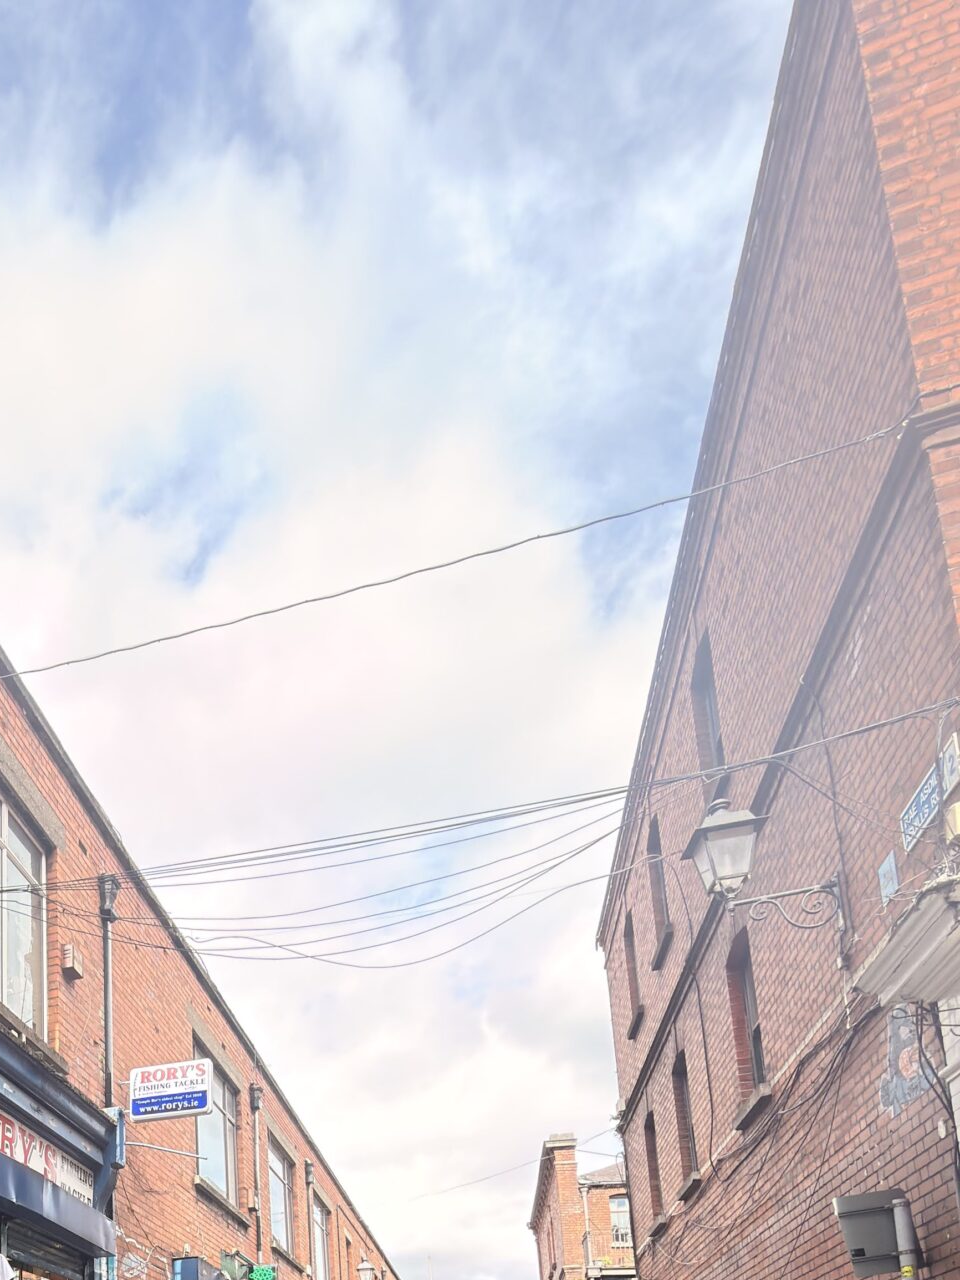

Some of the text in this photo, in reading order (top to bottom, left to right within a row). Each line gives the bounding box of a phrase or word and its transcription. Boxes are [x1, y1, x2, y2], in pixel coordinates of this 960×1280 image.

[140, 1063, 206, 1084] RORY'S
[138, 1078, 206, 1092] FISHING TACKLE
[139, 1100, 199, 1113] www.rorys.ie
[61, 1155, 93, 1188] FISHING
